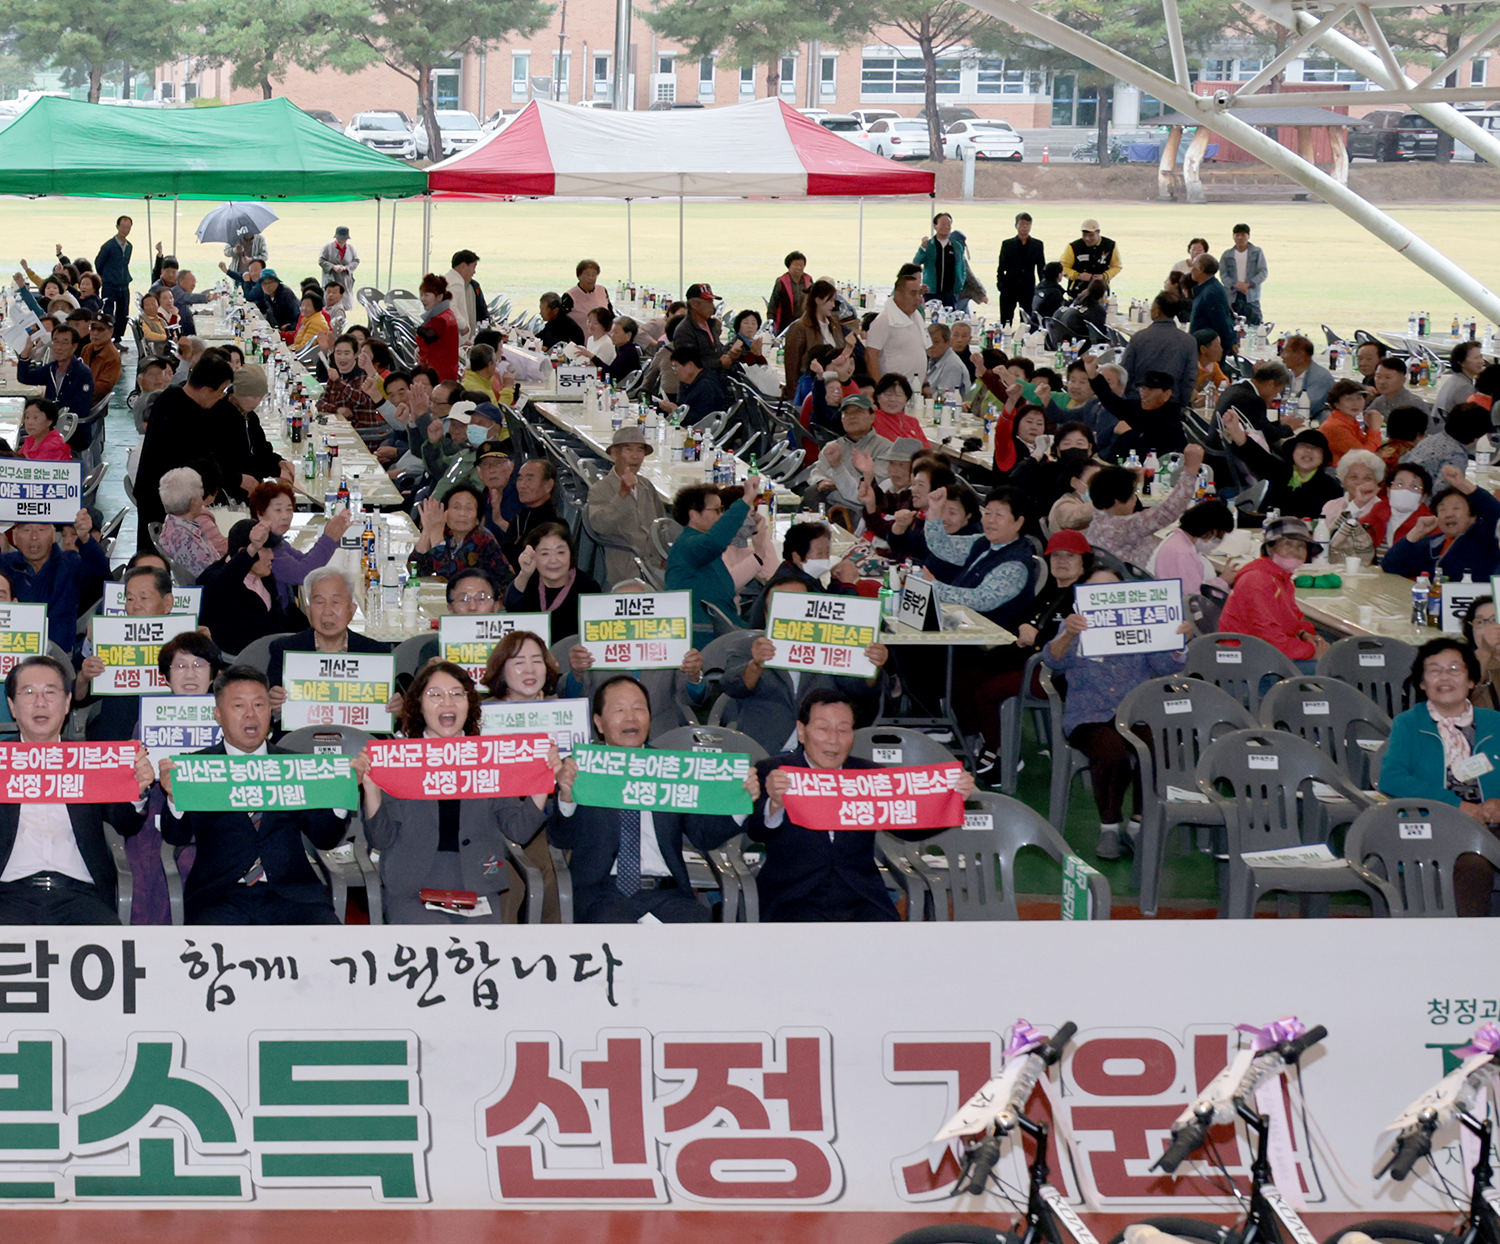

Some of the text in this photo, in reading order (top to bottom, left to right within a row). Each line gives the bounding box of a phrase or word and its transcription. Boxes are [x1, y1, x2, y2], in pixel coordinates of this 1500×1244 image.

[0, 465, 31, 479] 인구소멸
[23, 482, 44, 498] 기본
[46, 483, 77, 499] 소득이
[16, 501, 51, 516] 만든다!
[615, 598, 655, 617] 괴산군
[1090, 591, 1126, 605] 인구소멸
[805, 600, 845, 620] 괴산군
[1118, 605, 1180, 625] 기본 소득이
[124, 622, 164, 642] 괴산군
[586, 618, 685, 641] 농어촌 기본소득
[773, 620, 813, 641] 농어촌
[1114, 629, 1152, 646] 만든다!
[97, 644, 136, 666] 농어촌
[446, 643, 487, 664] 농어촌
[605, 642, 667, 663] 선정 기원!
[789, 645, 852, 667] 선정 기원!
[113, 668, 140, 688] 선정
[318, 659, 359, 678] 괴산군
[289, 680, 388, 703] 농어촌 기본소득
[156, 705, 198, 720] 인구소멸
[307, 705, 369, 726] 선정 기원!
[145, 726, 184, 746] 농어촌
[187, 726, 212, 746] 기본
[11, 745, 64, 770] 농어촌
[68, 744, 136, 770] 기본소득
[371, 737, 550, 768] 괴산군 농어촌 기본소득
[175, 755, 352, 782] 괴산군 농어촌 기본소득
[576, 748, 750, 783] 괴산군 농어촌 기본소득
[6, 773, 84, 798] 선정 기원!
[422, 768, 500, 796] 선정 기원!
[840, 770, 893, 796] 농어촌
[229, 784, 305, 808] 선정 기원!
[622, 781, 698, 808] 선정 기원!
[838, 800, 917, 825] 선정 기원!
[181, 937, 297, 1012] 함께
[329, 937, 619, 1012] 기원합니다
[485, 1037, 832, 1200] 선정
